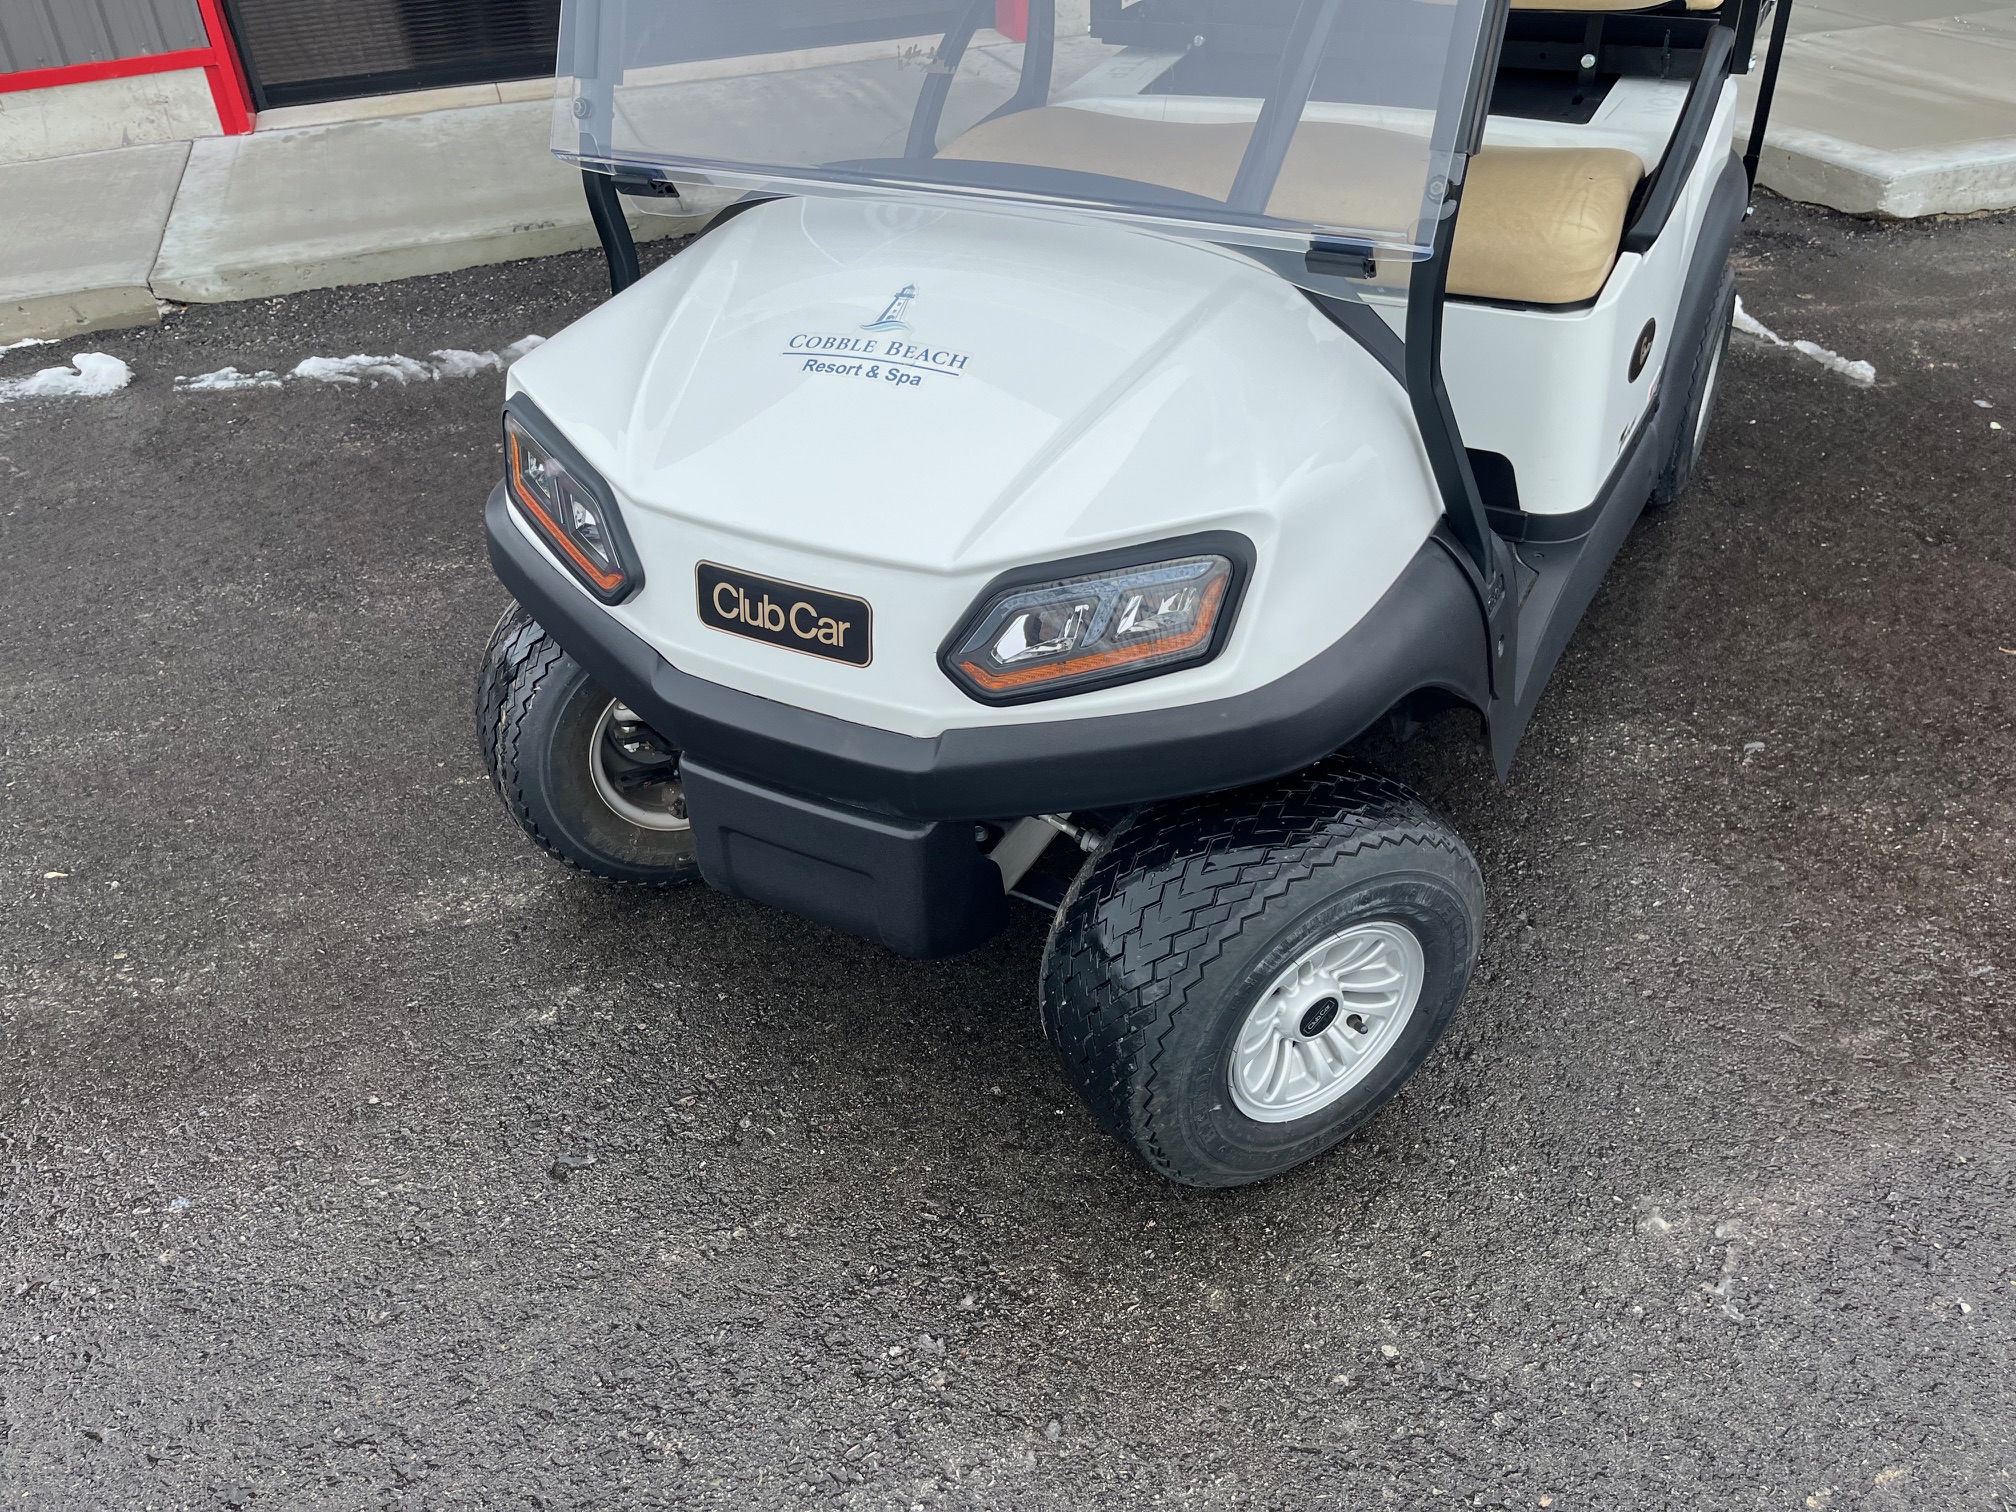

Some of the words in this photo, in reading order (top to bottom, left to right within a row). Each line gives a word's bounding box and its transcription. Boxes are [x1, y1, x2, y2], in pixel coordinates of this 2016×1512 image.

[789, 334, 877, 354] COBBLE
[885, 341, 970, 370] BEACH
[802, 359, 863, 376] Resort
[866, 365, 880, 379] &
[885, 368, 922, 386] Spa
[713, 582, 786, 632] Club
[789, 602, 851, 648] Car
[1307, 1015, 1321, 1030] Club
[1319, 1004, 1331, 1016] Car
